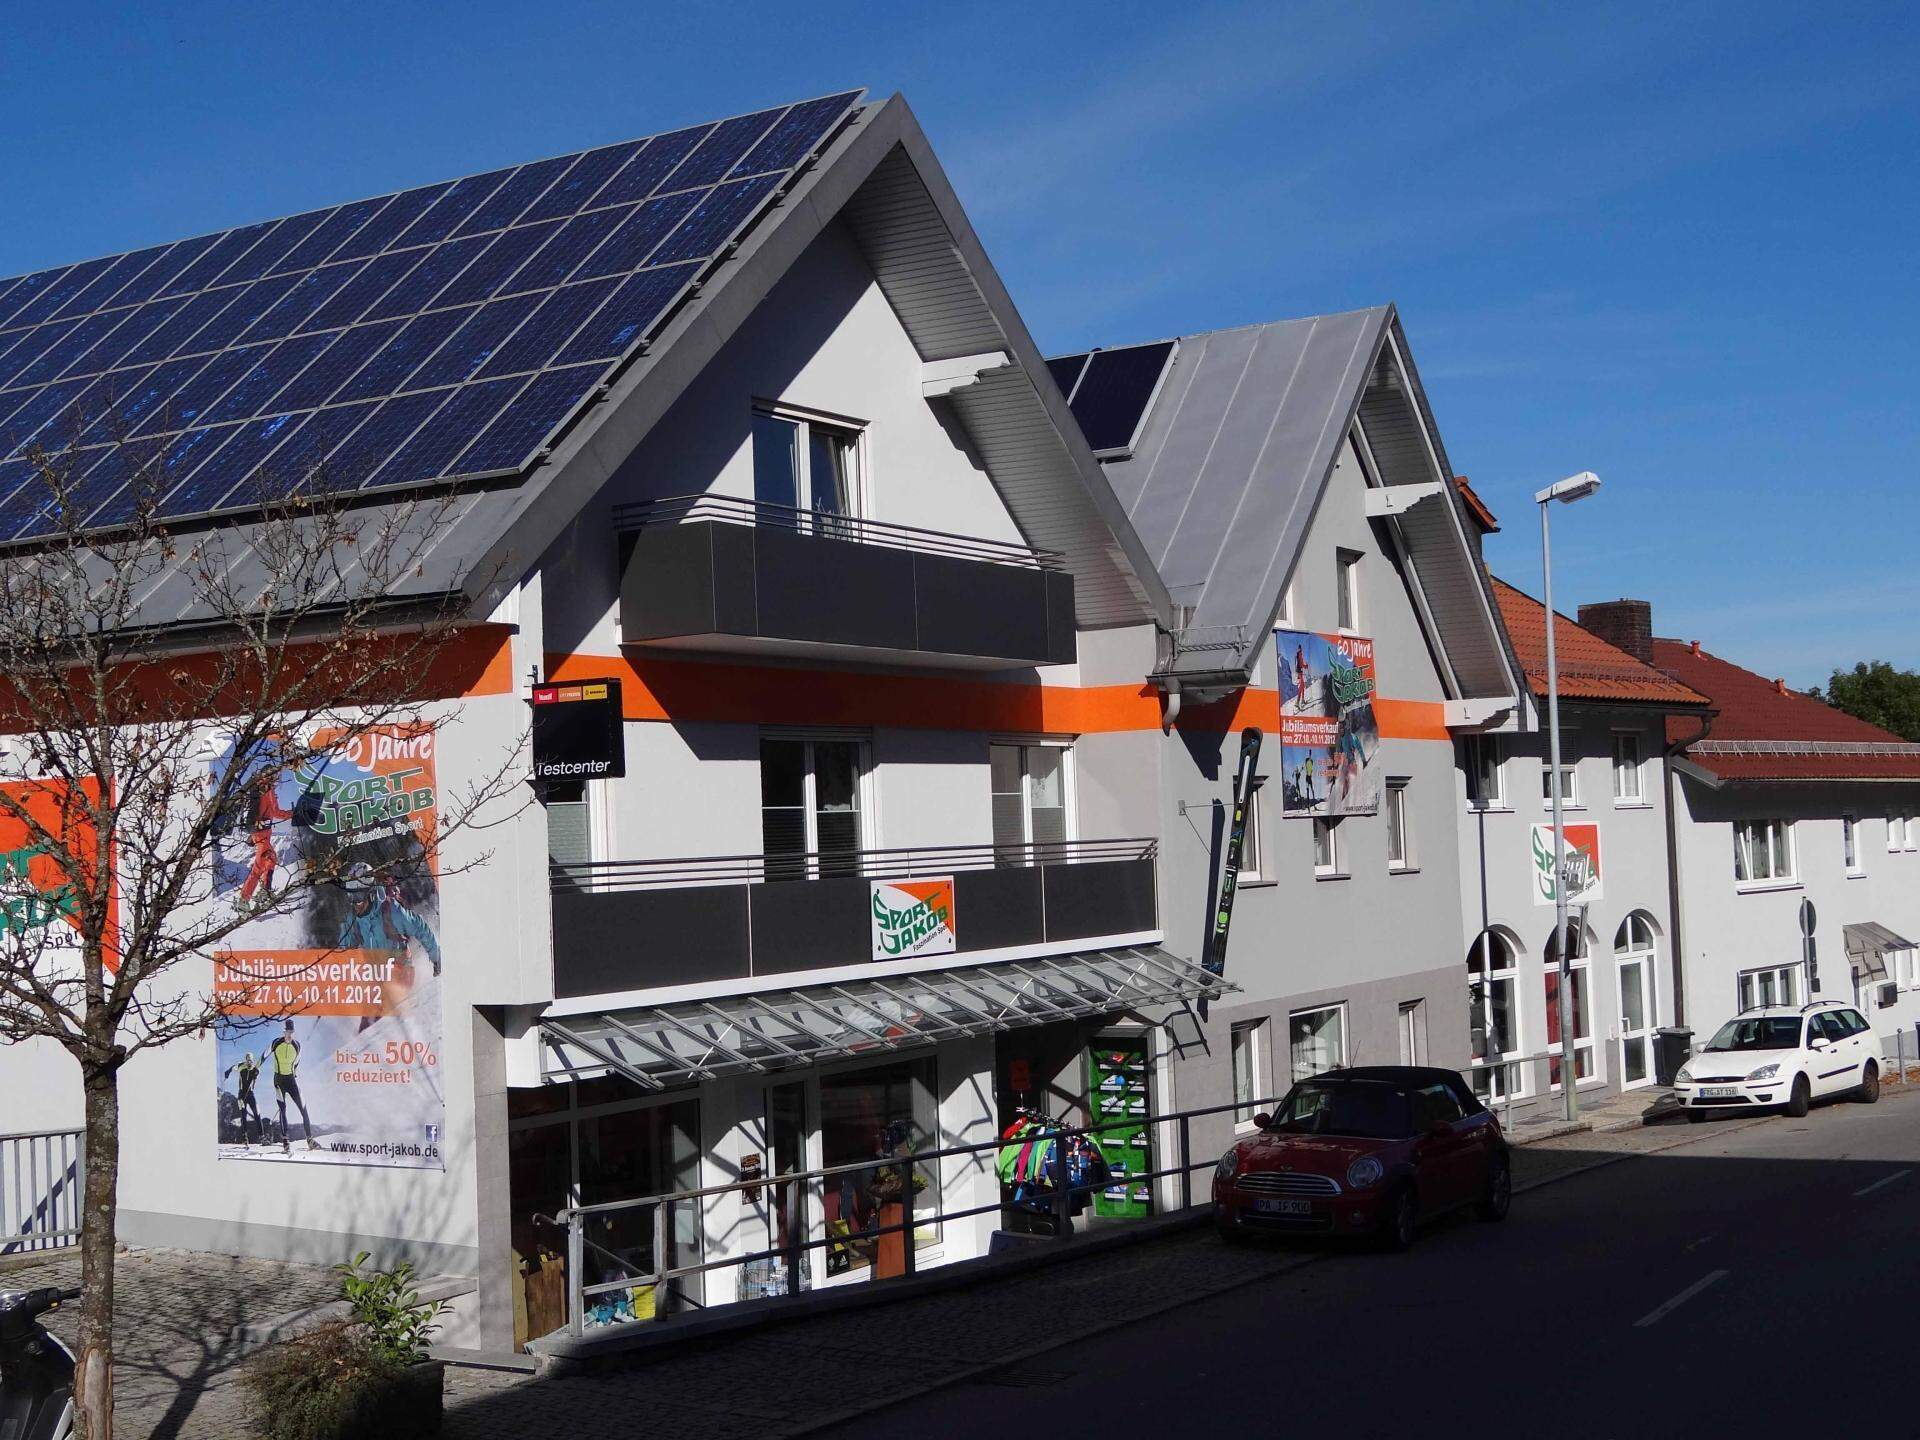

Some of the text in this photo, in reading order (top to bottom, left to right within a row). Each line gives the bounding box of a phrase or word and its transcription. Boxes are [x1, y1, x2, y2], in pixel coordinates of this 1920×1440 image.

[1347, 639, 1372, 662] Jahre
[1282, 719, 1339, 733] Jubiläumsverkauf
[357, 726, 432, 772] Jahre
[536, 760, 610, 776] Testcenter
[293, 762, 423, 805] SPORT
[301, 787, 435, 834] JAKOB
[395, 817, 424, 835] Sport
[873, 892, 941, 930] SPORT
[880, 905, 948, 954] JAKOB
[218, 957, 395, 982] Jubiläumsverkauf
[254, 985, 382, 1005] 27.10.-10.11.2012
[336, 1041, 437, 1066] bis zu 50%
[336, 1068, 411, 1083] reduziert!
[330, 1142, 438, 1158] www.sport-jakob.de
